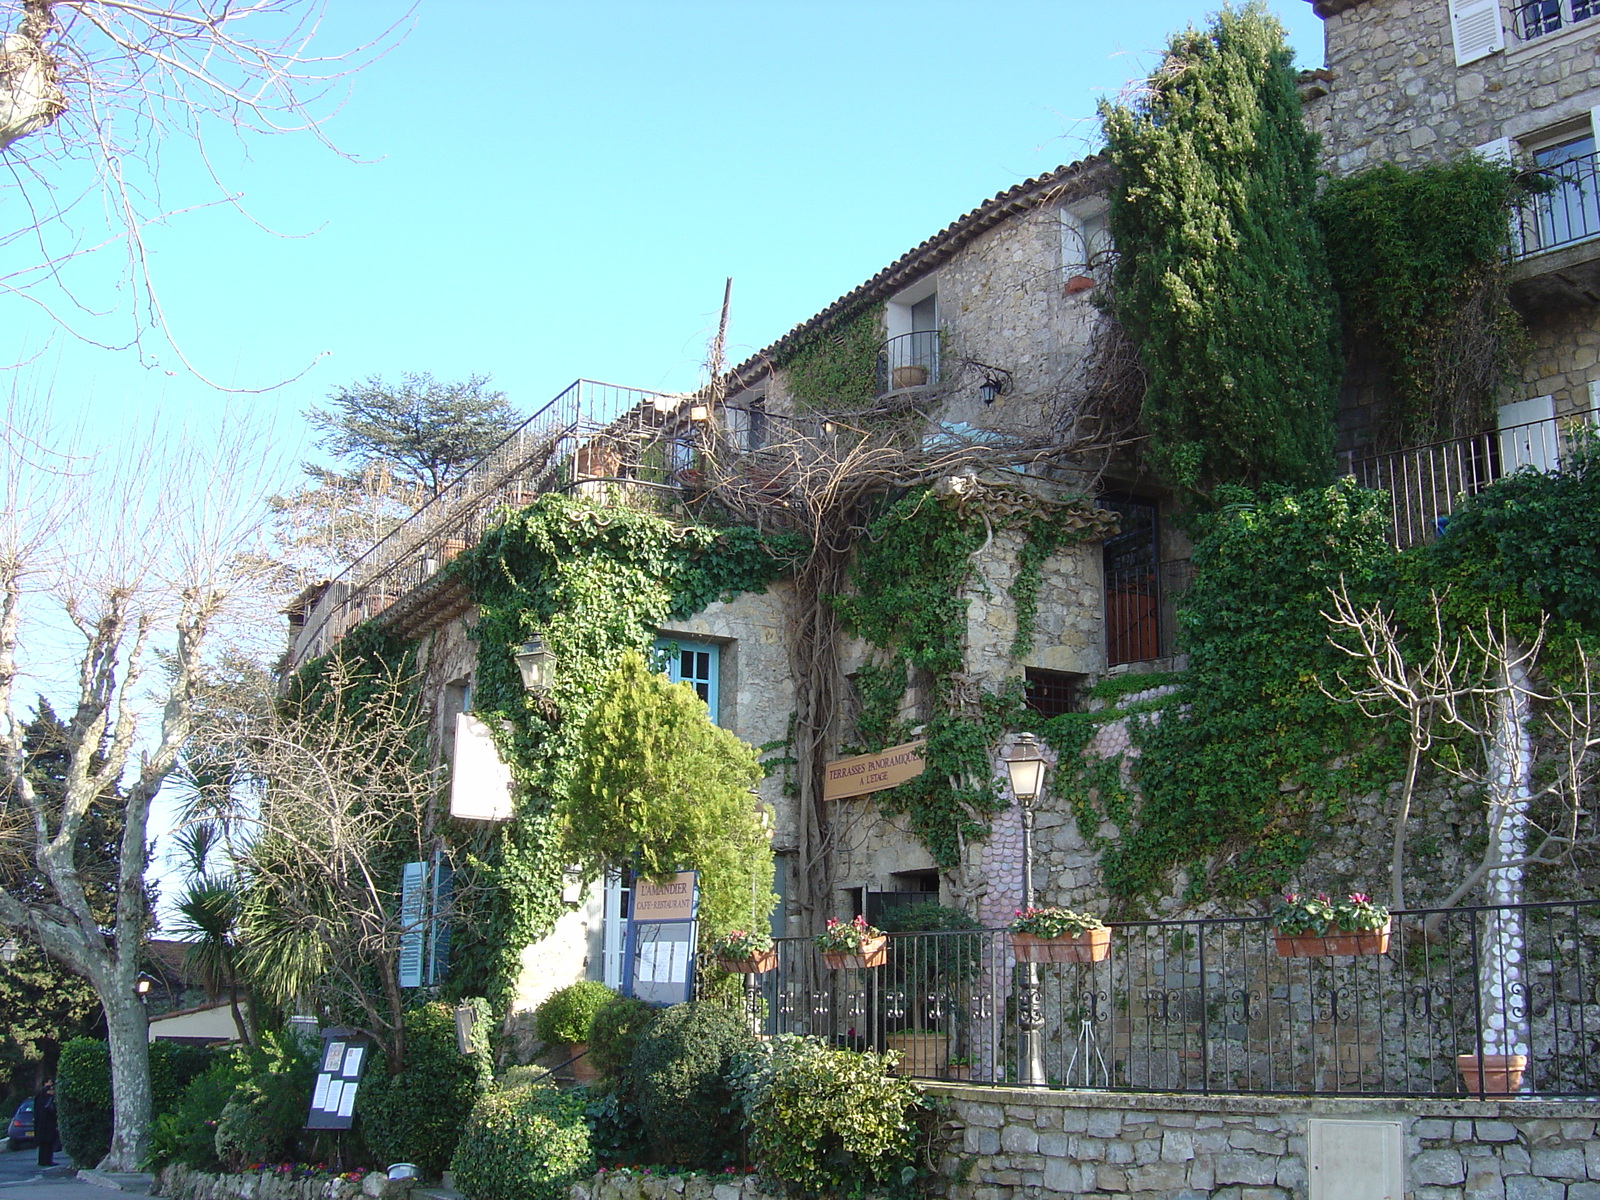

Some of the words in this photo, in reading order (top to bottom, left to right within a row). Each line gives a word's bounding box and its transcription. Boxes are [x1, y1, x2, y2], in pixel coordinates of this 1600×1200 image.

[829, 763, 865, 780] TERRASSES
[868, 751, 919, 772] PANORAMIQUE
[860, 777, 864, 786] A
[641, 882, 687, 896] L'AMANDIER
